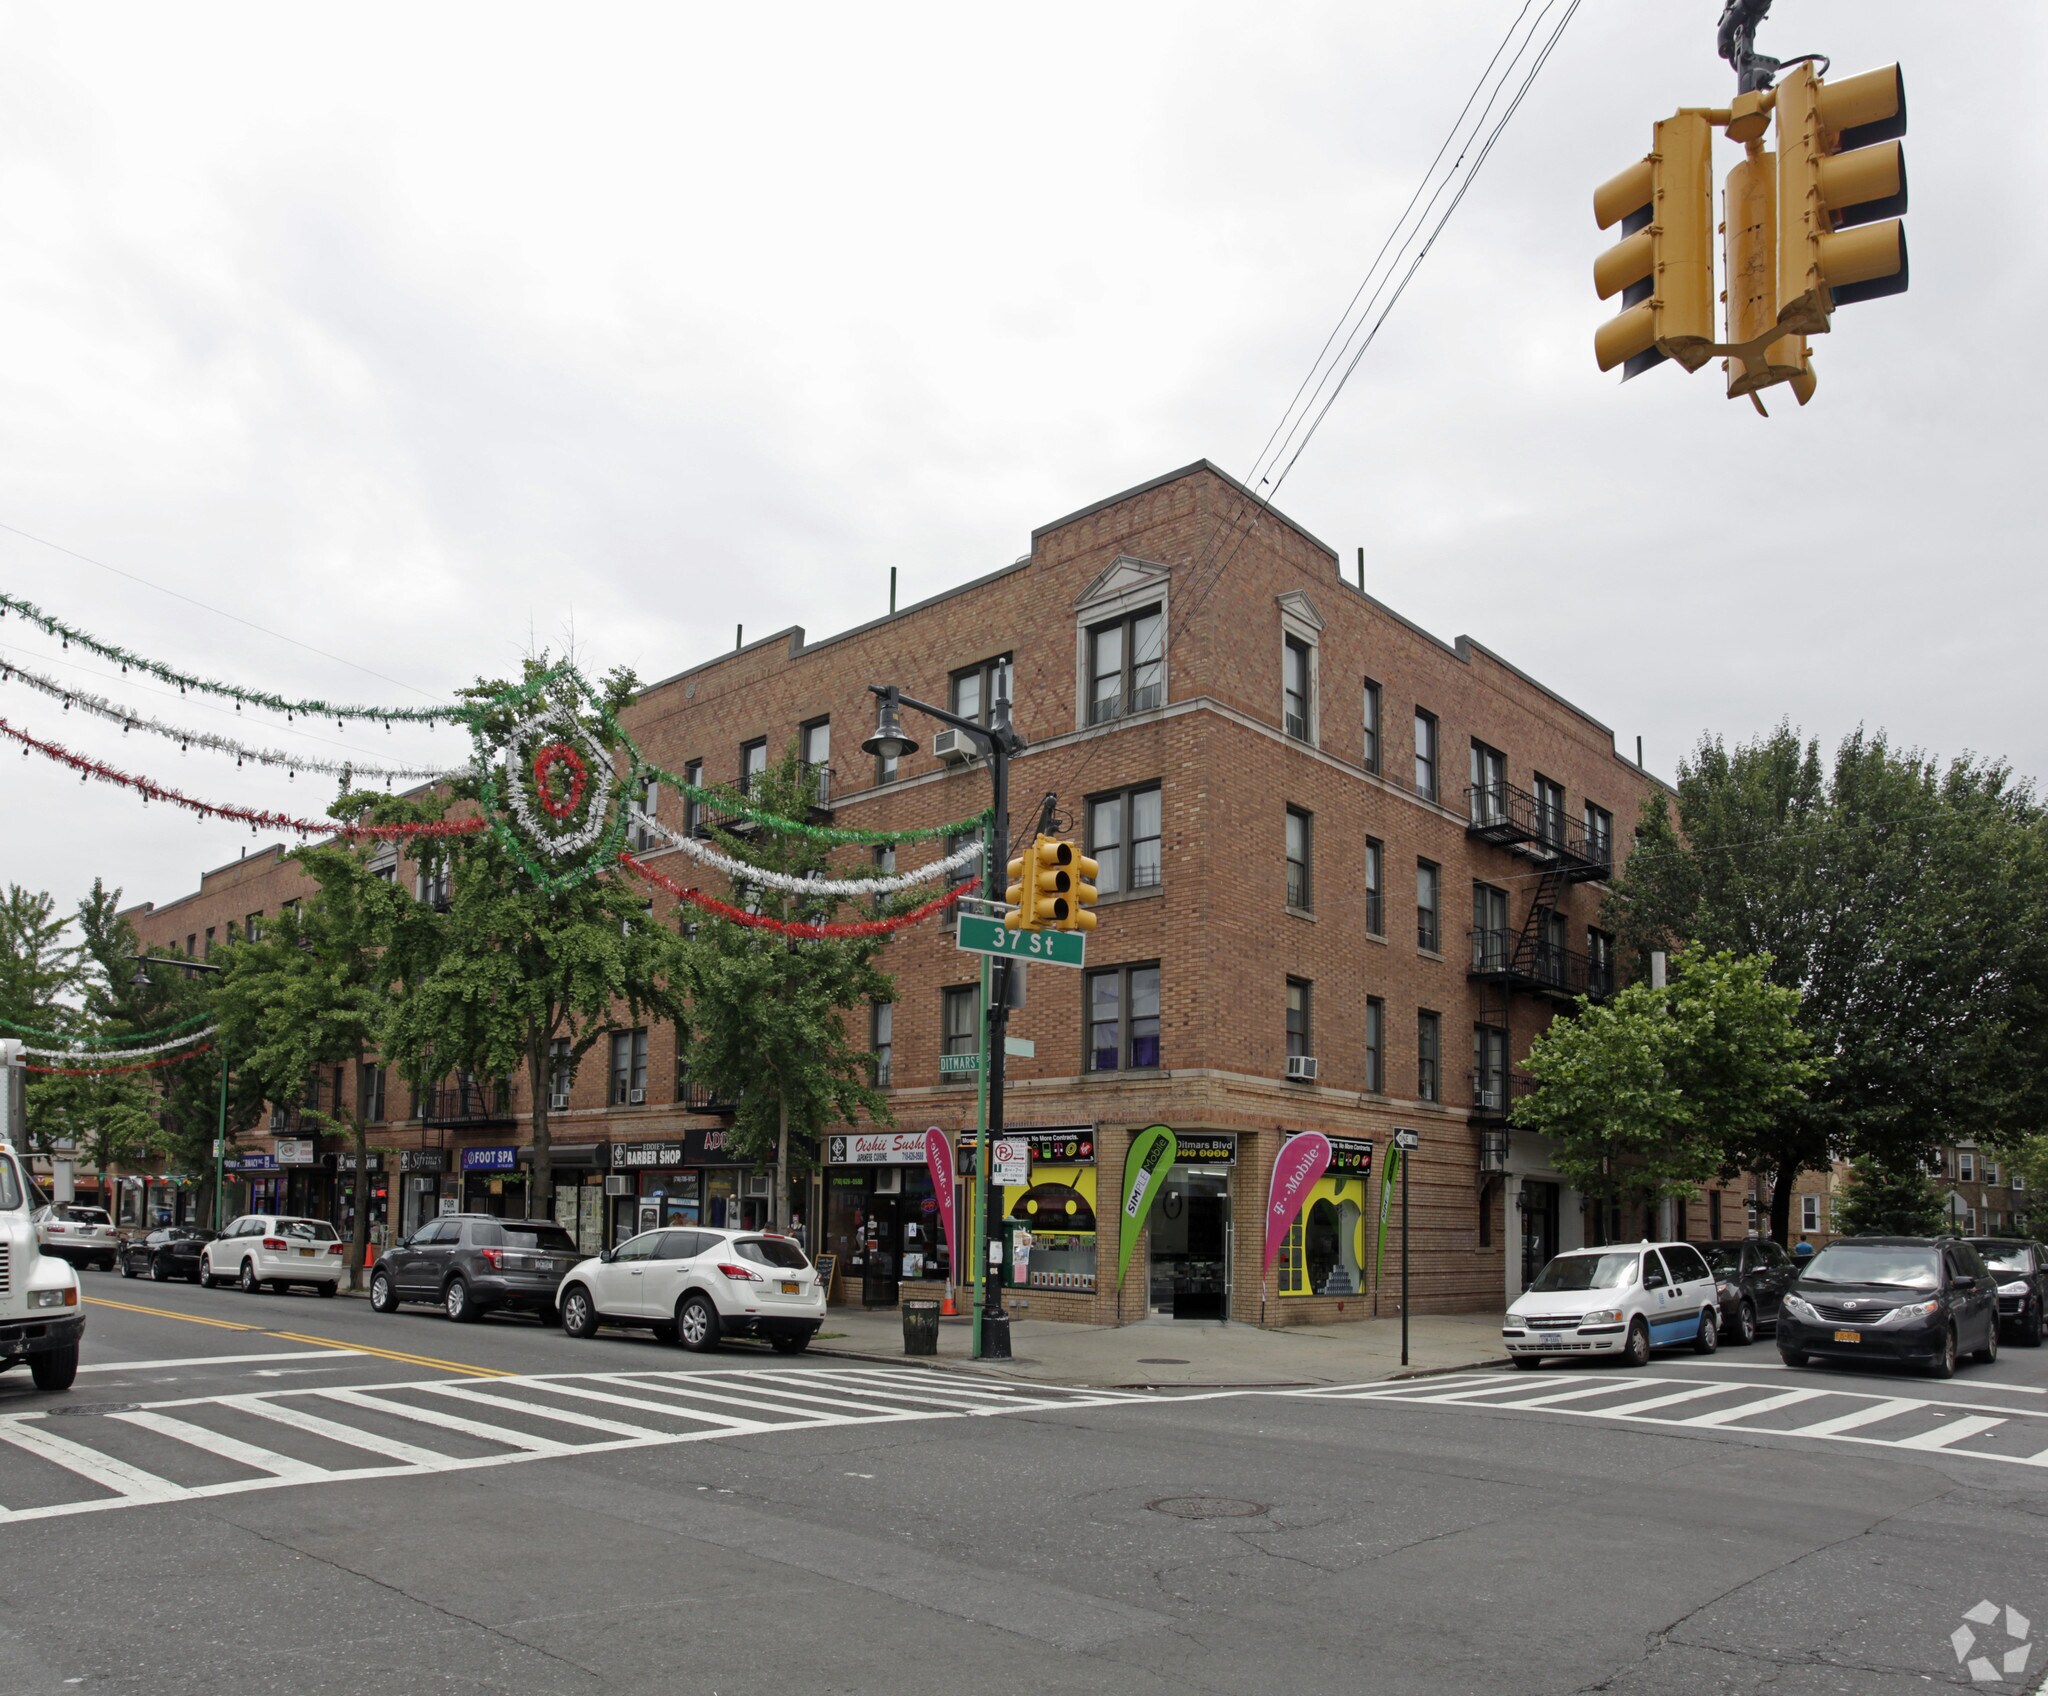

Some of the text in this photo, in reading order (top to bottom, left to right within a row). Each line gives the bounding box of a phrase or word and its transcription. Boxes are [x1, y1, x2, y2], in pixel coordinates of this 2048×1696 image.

[992, 927, 1054, 955] 37 St
[940, 1056, 976, 1071] DITMARS
[642, 1143, 665, 1151] EDDIE'S
[855, 1137, 887, 1153] Oishii
[1212, 1140, 1232, 1149] Blvd
[474, 1150, 514, 1164] FOOT SPA
[626, 1149, 681, 1165] BARBER SHOP
[1128, 1138, 1167, 1214] SIMPLE Mobile
[444, 1199, 455, 1208] FOR
